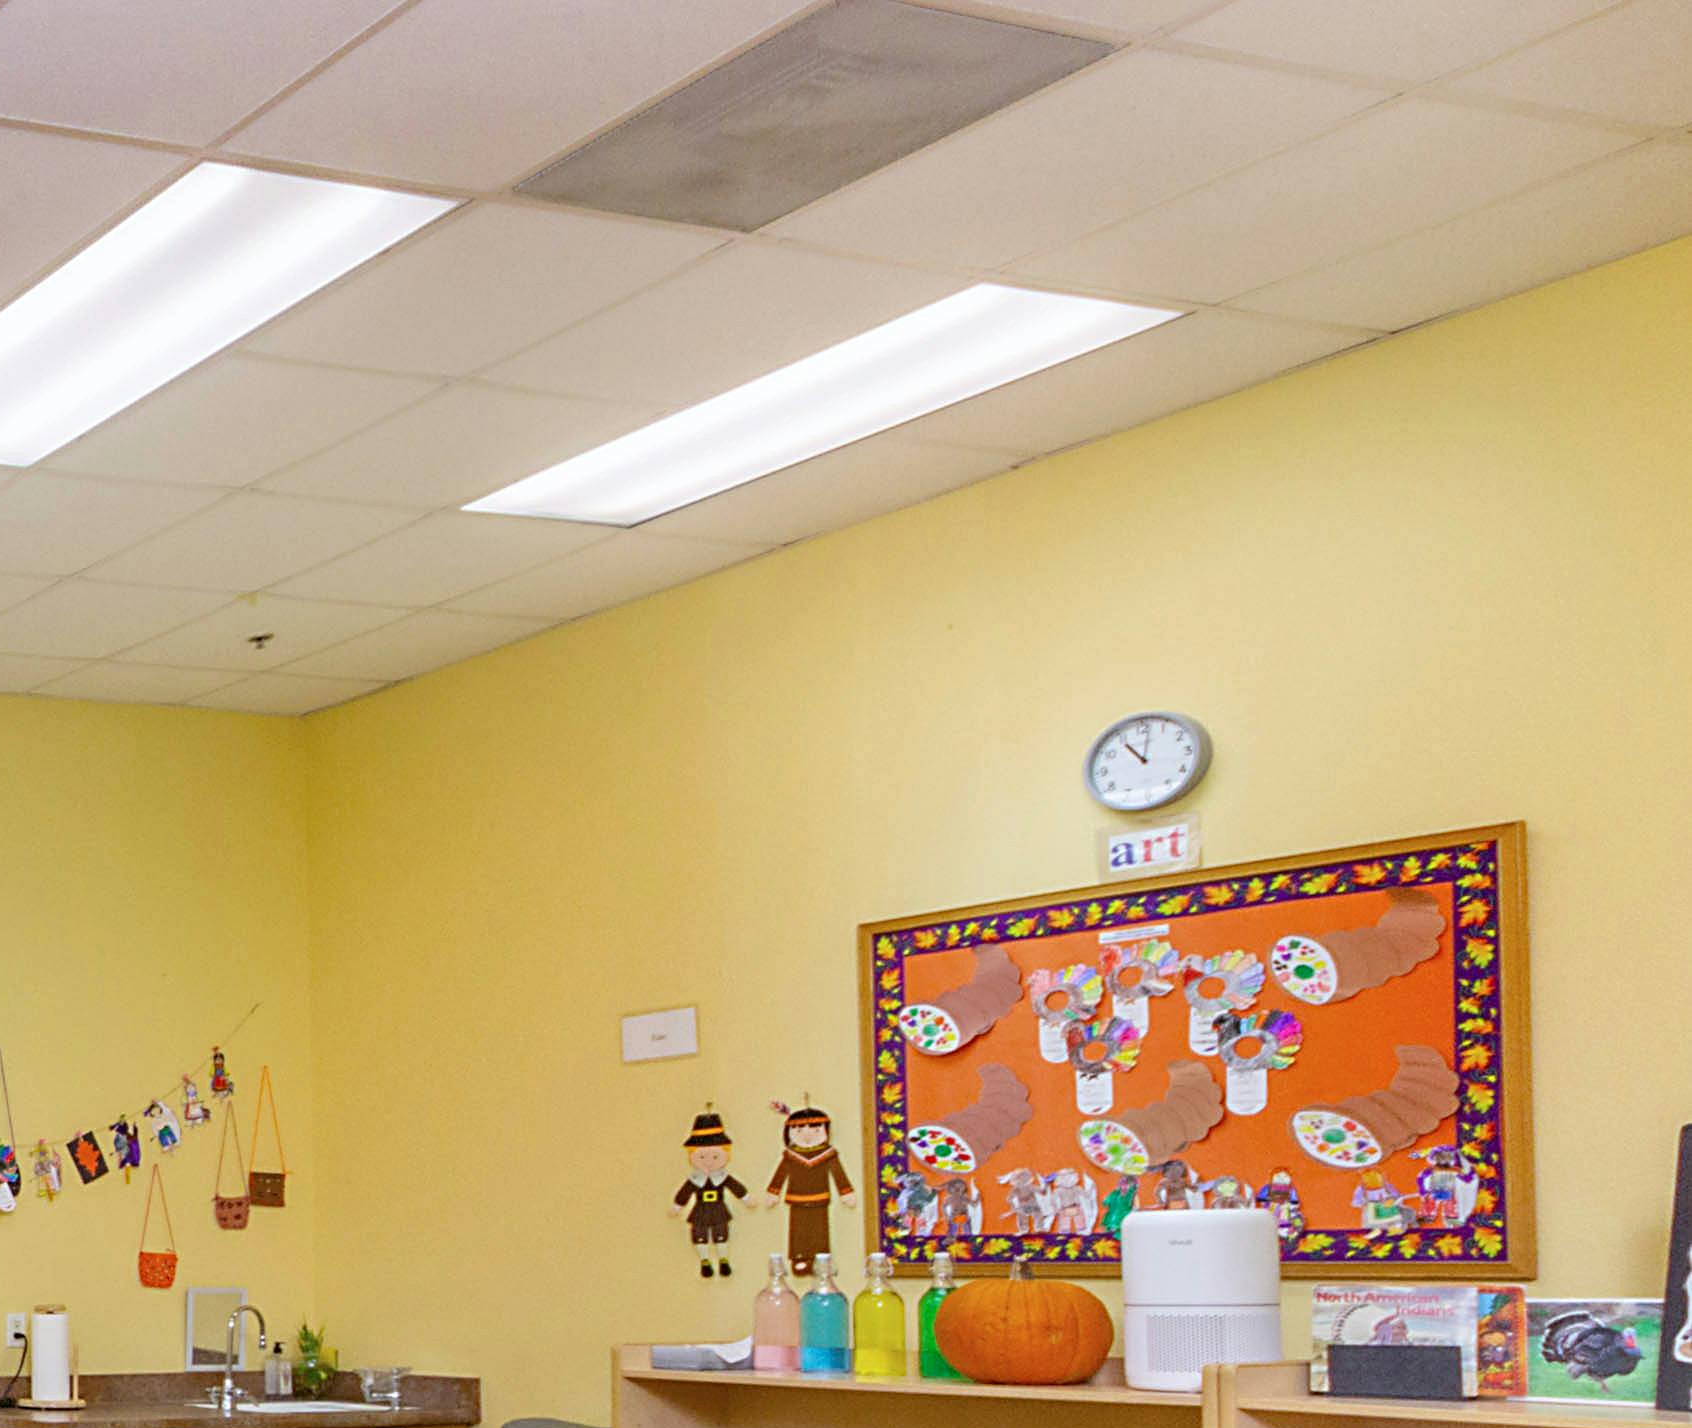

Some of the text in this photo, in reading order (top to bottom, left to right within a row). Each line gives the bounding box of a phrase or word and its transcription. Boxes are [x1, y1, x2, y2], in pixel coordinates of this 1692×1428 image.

[1136, 722, 1151, 736] 12
[1175, 730, 1184, 742] 2
[1183, 744, 1193, 756] 3
[1101, 767, 1108, 777] 9
[1179, 763, 1186, 773] 4
[1111, 828, 1185, 867] art
[1316, 1292, 1439, 1303] North American
